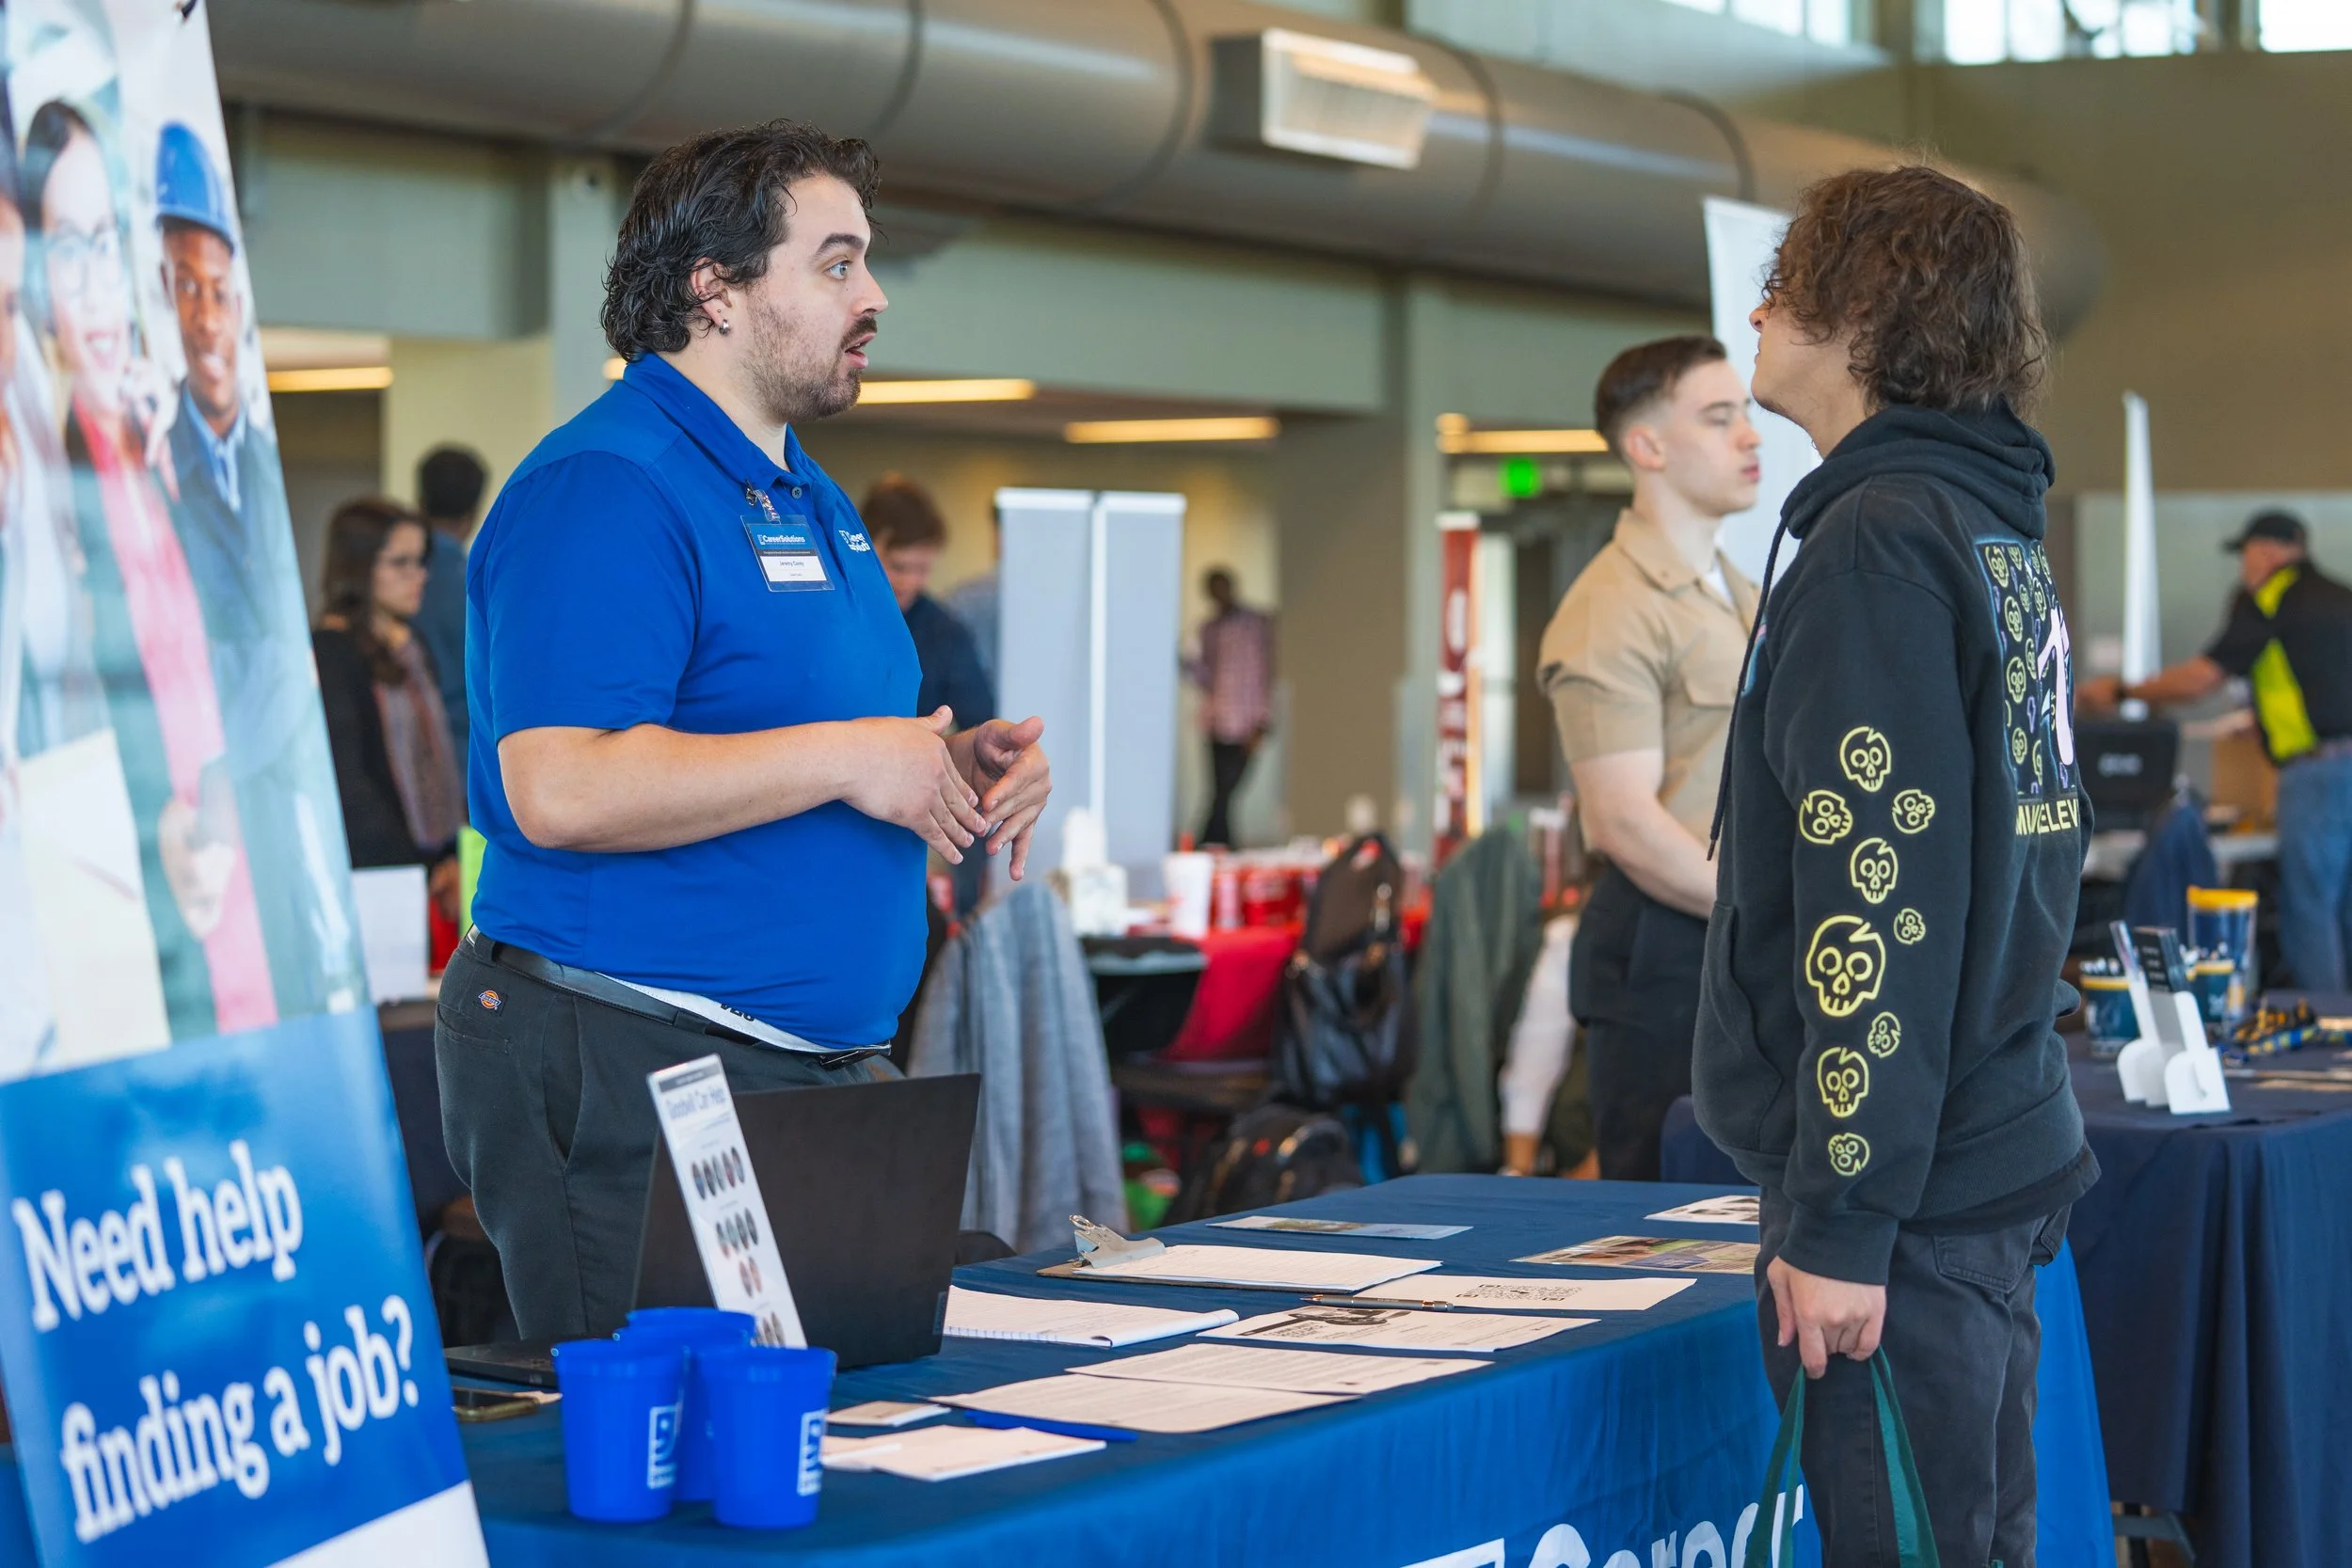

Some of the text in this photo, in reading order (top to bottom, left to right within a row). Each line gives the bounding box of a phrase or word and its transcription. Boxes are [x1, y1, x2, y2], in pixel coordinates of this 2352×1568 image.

[11, 1139, 304, 1333] Need help
[60, 1294, 419, 1544] finding a job?
